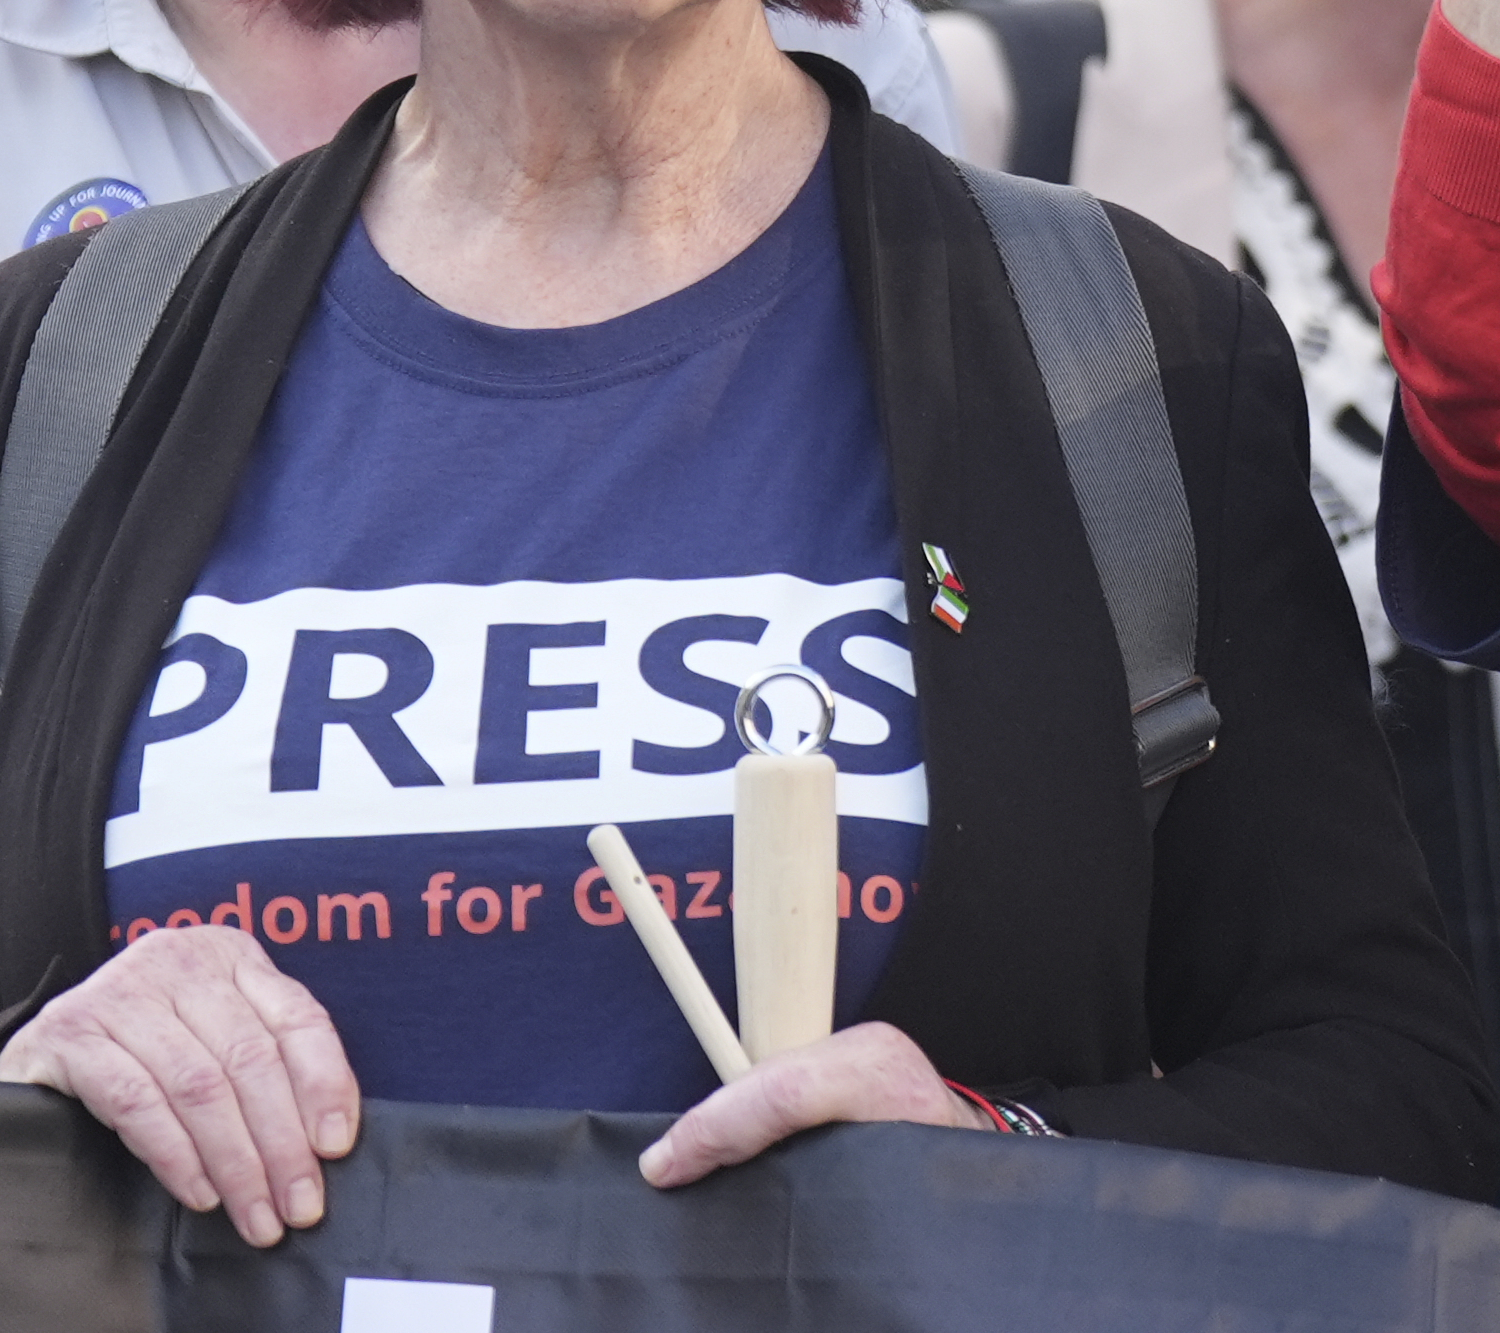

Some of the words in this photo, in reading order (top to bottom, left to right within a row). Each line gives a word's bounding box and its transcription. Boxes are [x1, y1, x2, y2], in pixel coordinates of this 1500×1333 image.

[48, 203, 67, 223] UP
[68, 187, 97, 208] FOR
[135, 608, 925, 815] PRESS
[426, 872, 544, 936] for
[573, 844, 736, 927] Gaz
